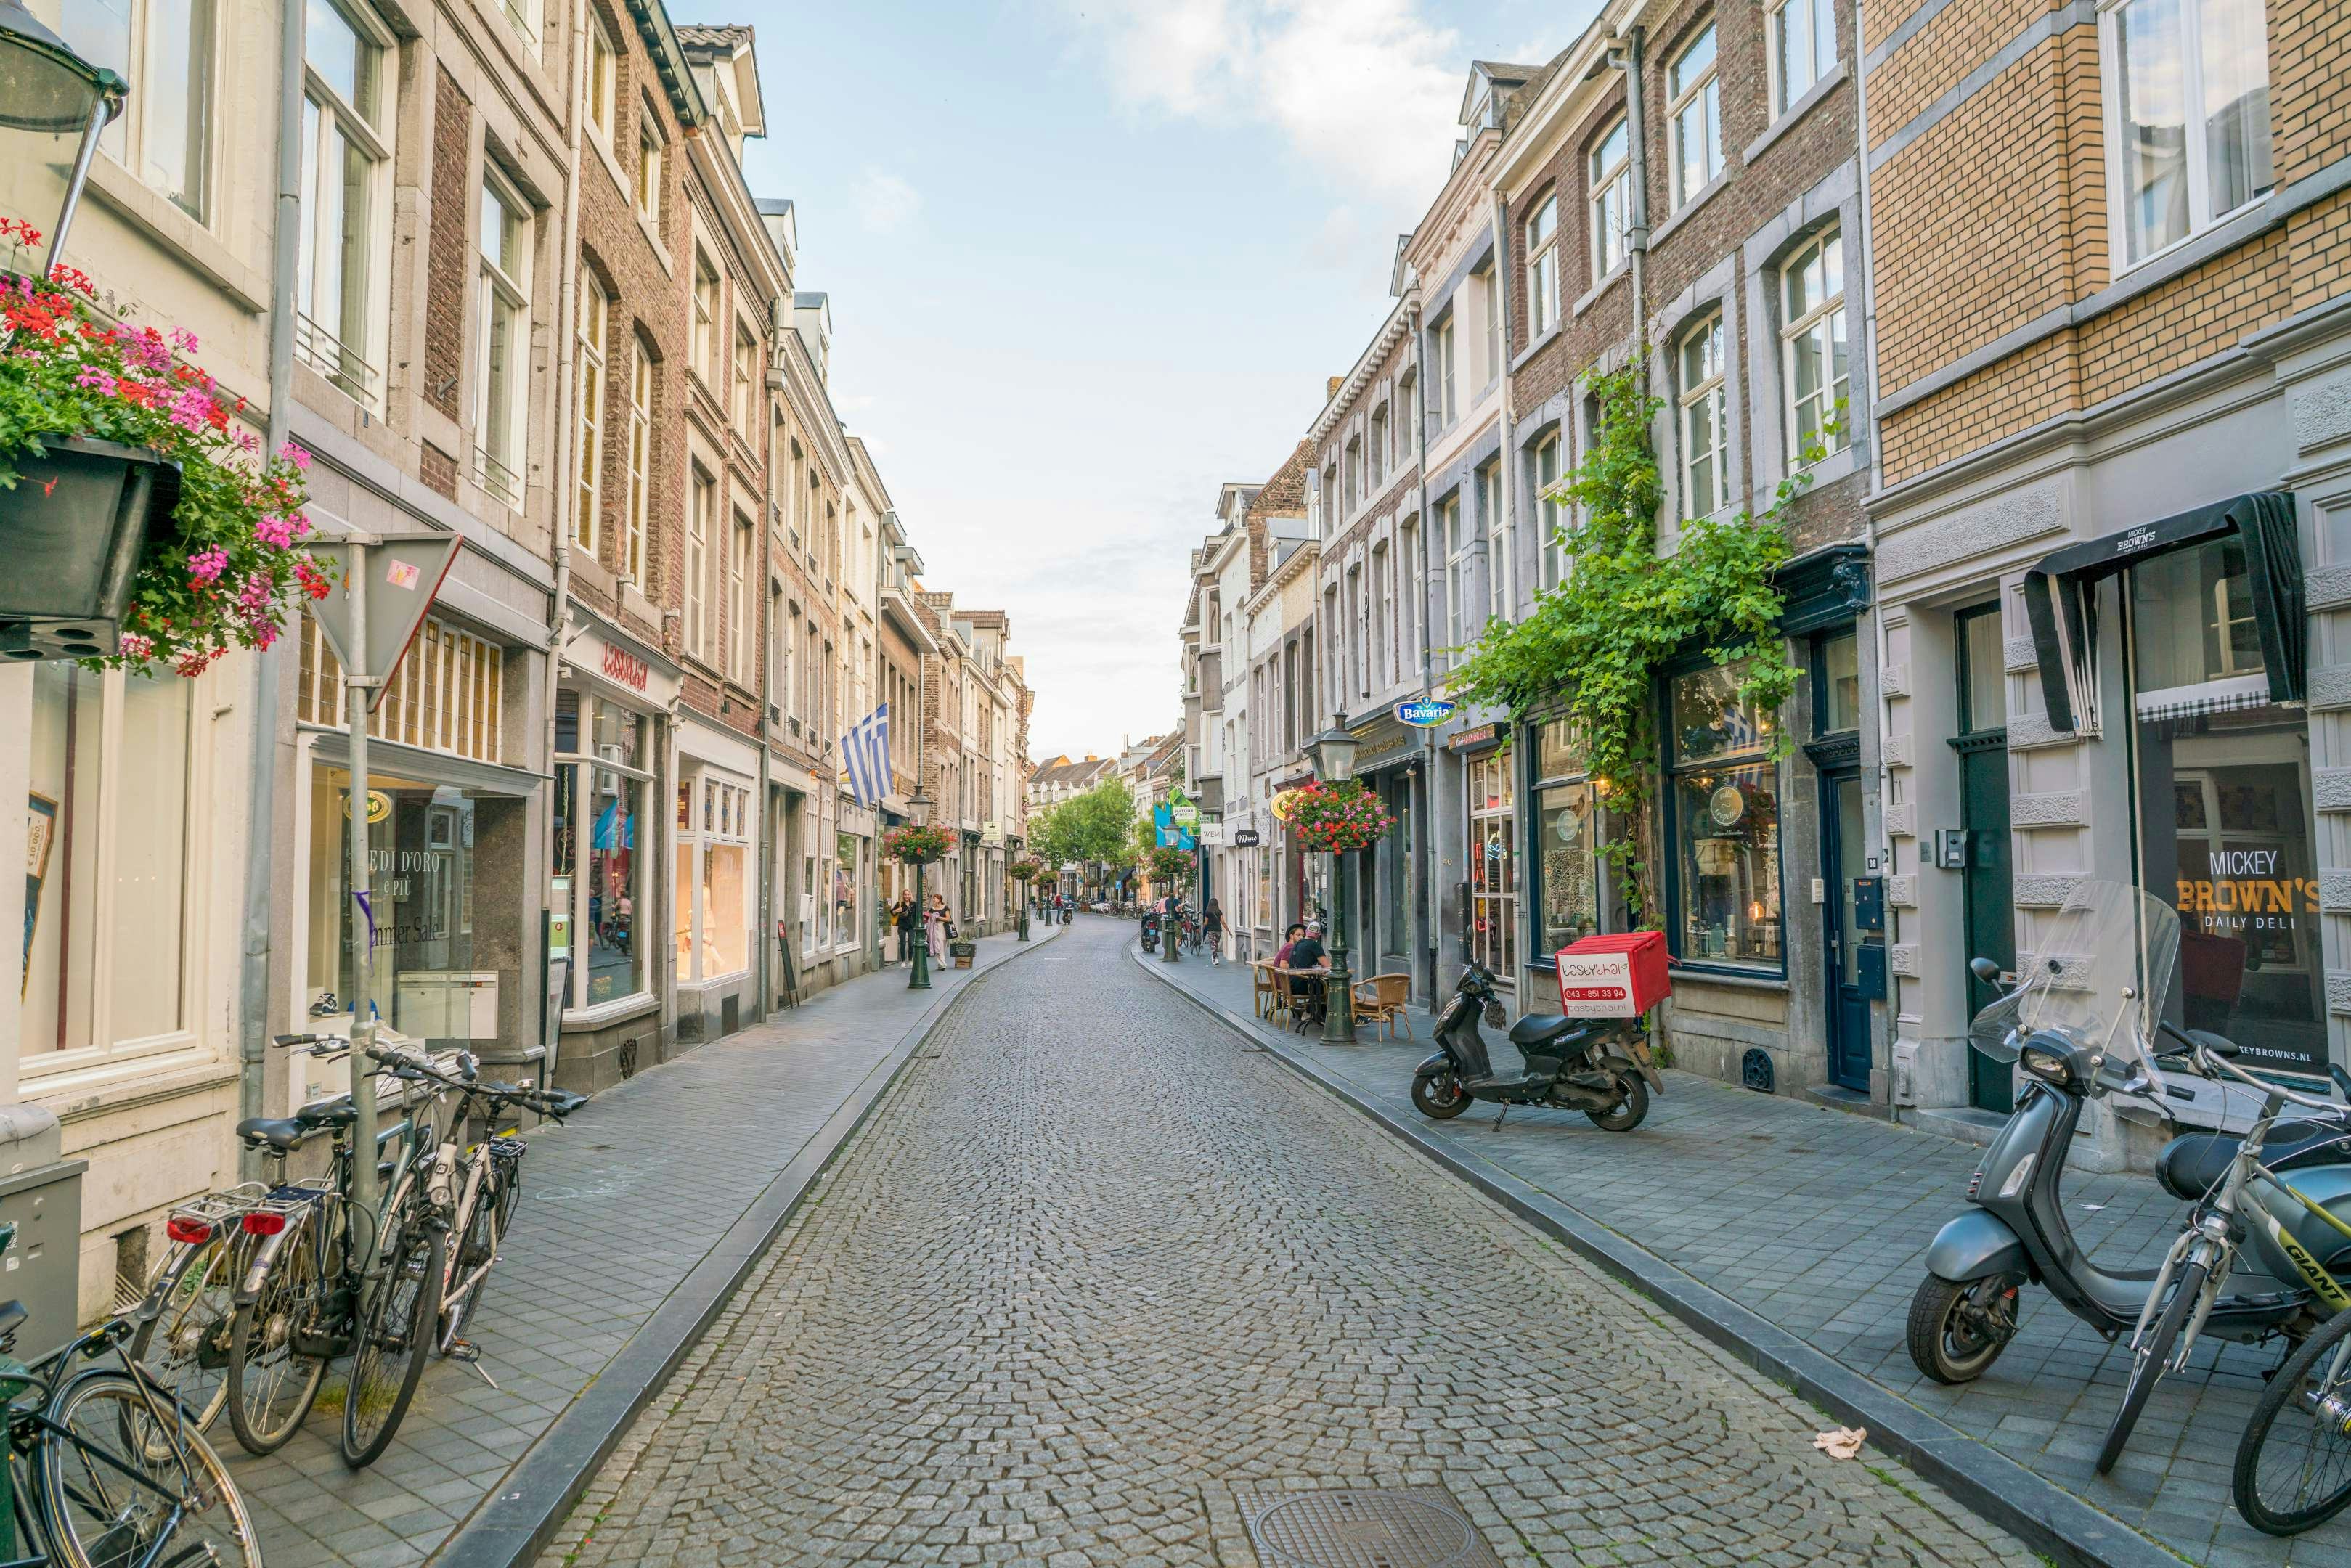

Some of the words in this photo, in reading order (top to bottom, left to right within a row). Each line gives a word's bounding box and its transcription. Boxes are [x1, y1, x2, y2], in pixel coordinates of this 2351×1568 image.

[2117, 531, 2156, 552] BROWN'S
[2127, 526, 2147, 539] MICKEY
[1403, 708, 1449, 719] Bavaria
[369, 850, 396, 872] EDI
[402, 851, 440, 873] D'ORO
[1869, 859, 1876, 868] 36
[2209, 850, 2278, 875] MICKEY
[393, 874, 412, 896] PIÙ
[2175, 877, 2321, 913] BROWN'S
[372, 923, 411, 947] mmer
[412, 916, 439, 942] Sale
[2204, 915, 2247, 928] DAILY
[2256, 917, 2294, 930] DELI
[2238, 1045, 2312, 1062] KEYBROWNS.NL
[2286, 1244, 2346, 1301] GIANT
